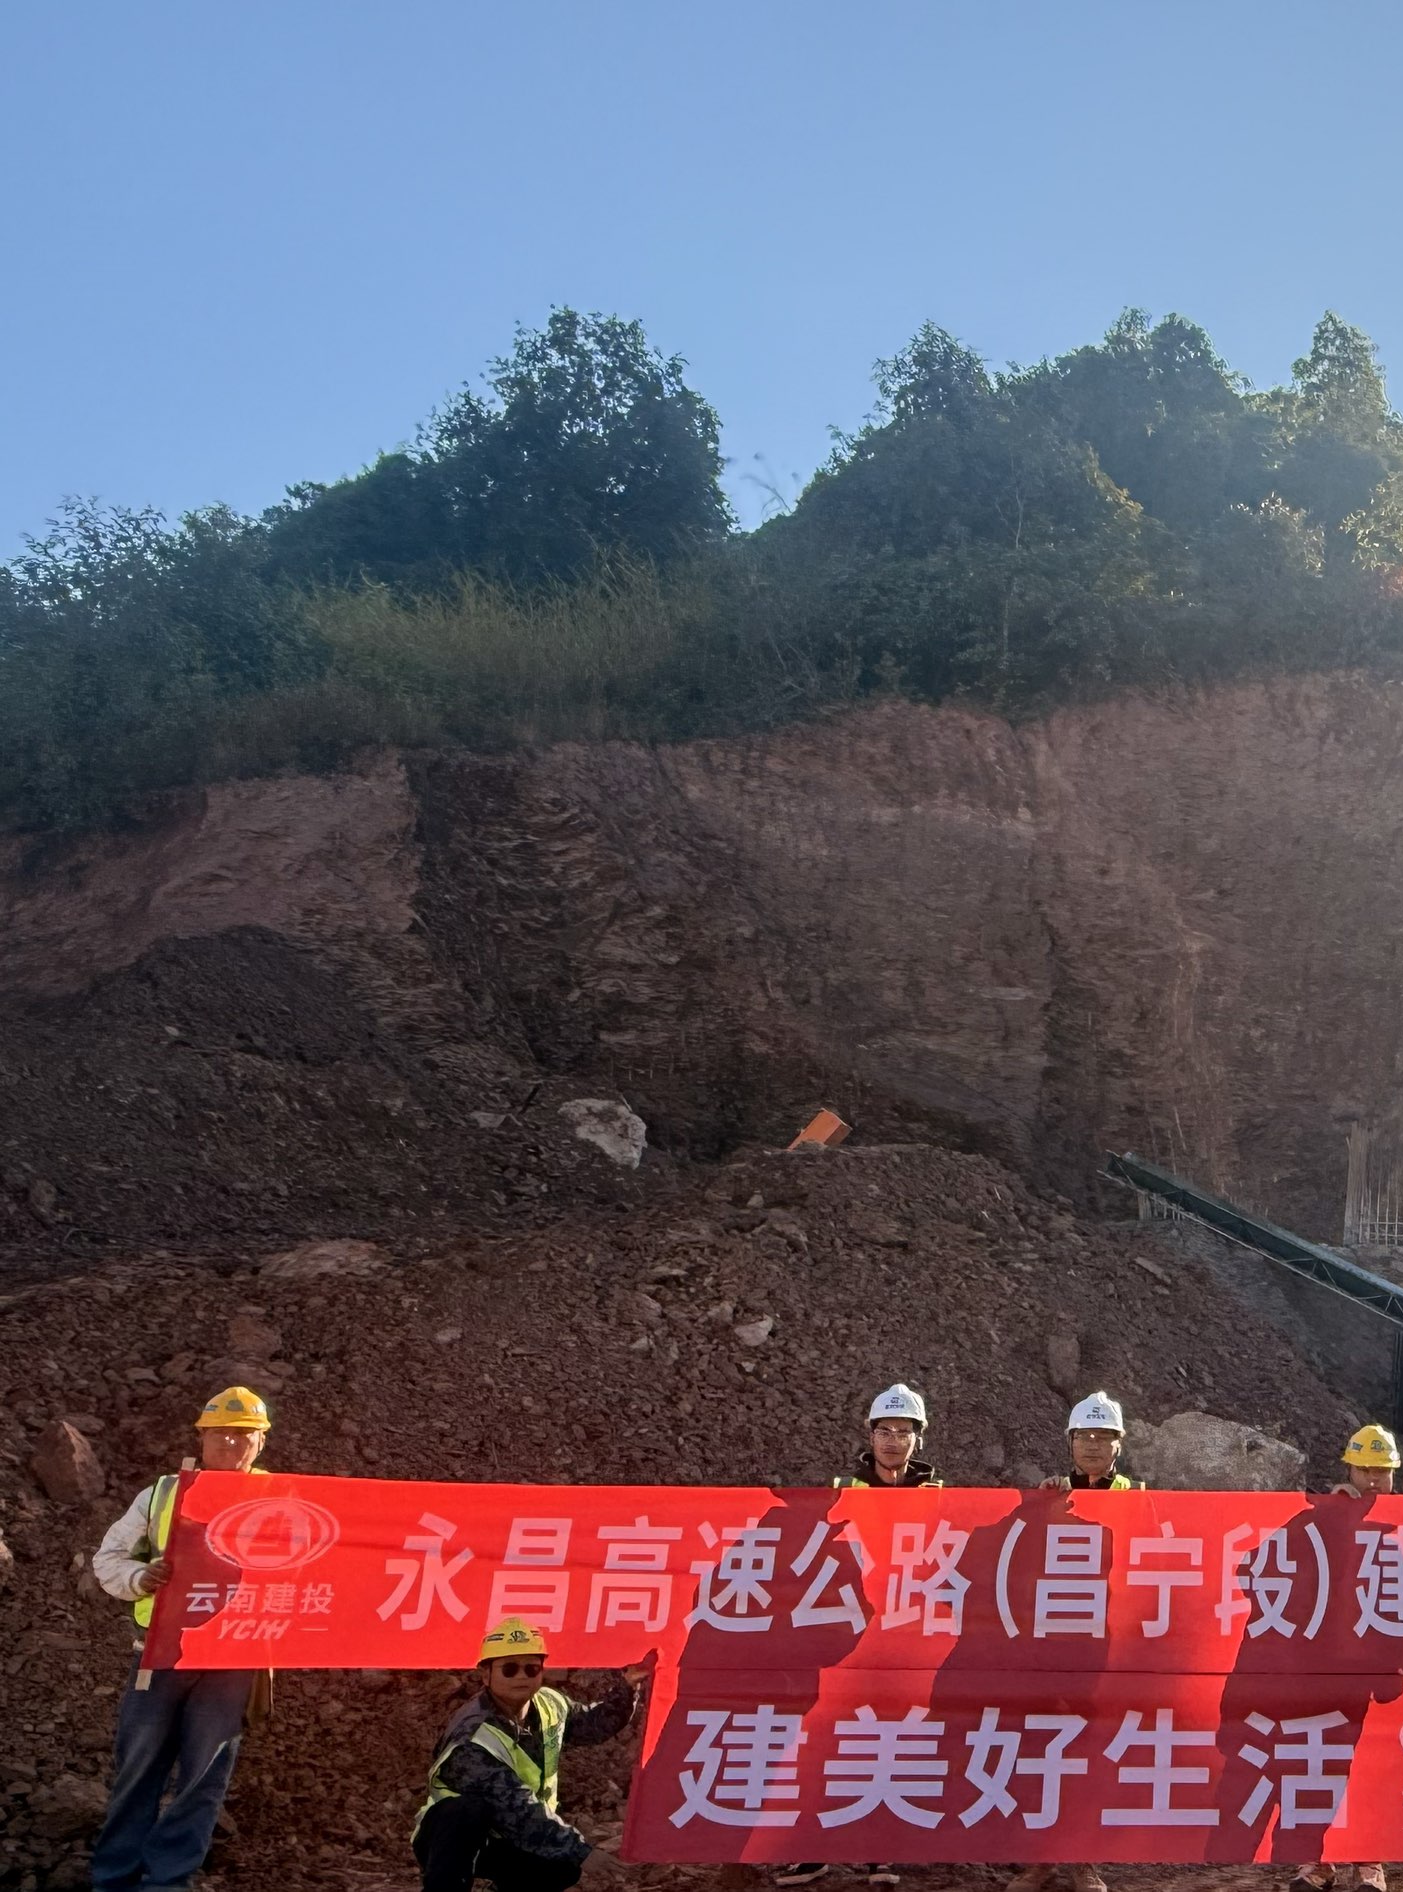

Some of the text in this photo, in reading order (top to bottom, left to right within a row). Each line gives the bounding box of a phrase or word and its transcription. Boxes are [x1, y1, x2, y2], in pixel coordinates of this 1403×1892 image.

[186, 1582, 335, 1615] 云南建投
[217, 1619, 291, 1640] YCIH
[668, 1705, 1355, 1830] 建美好生活
